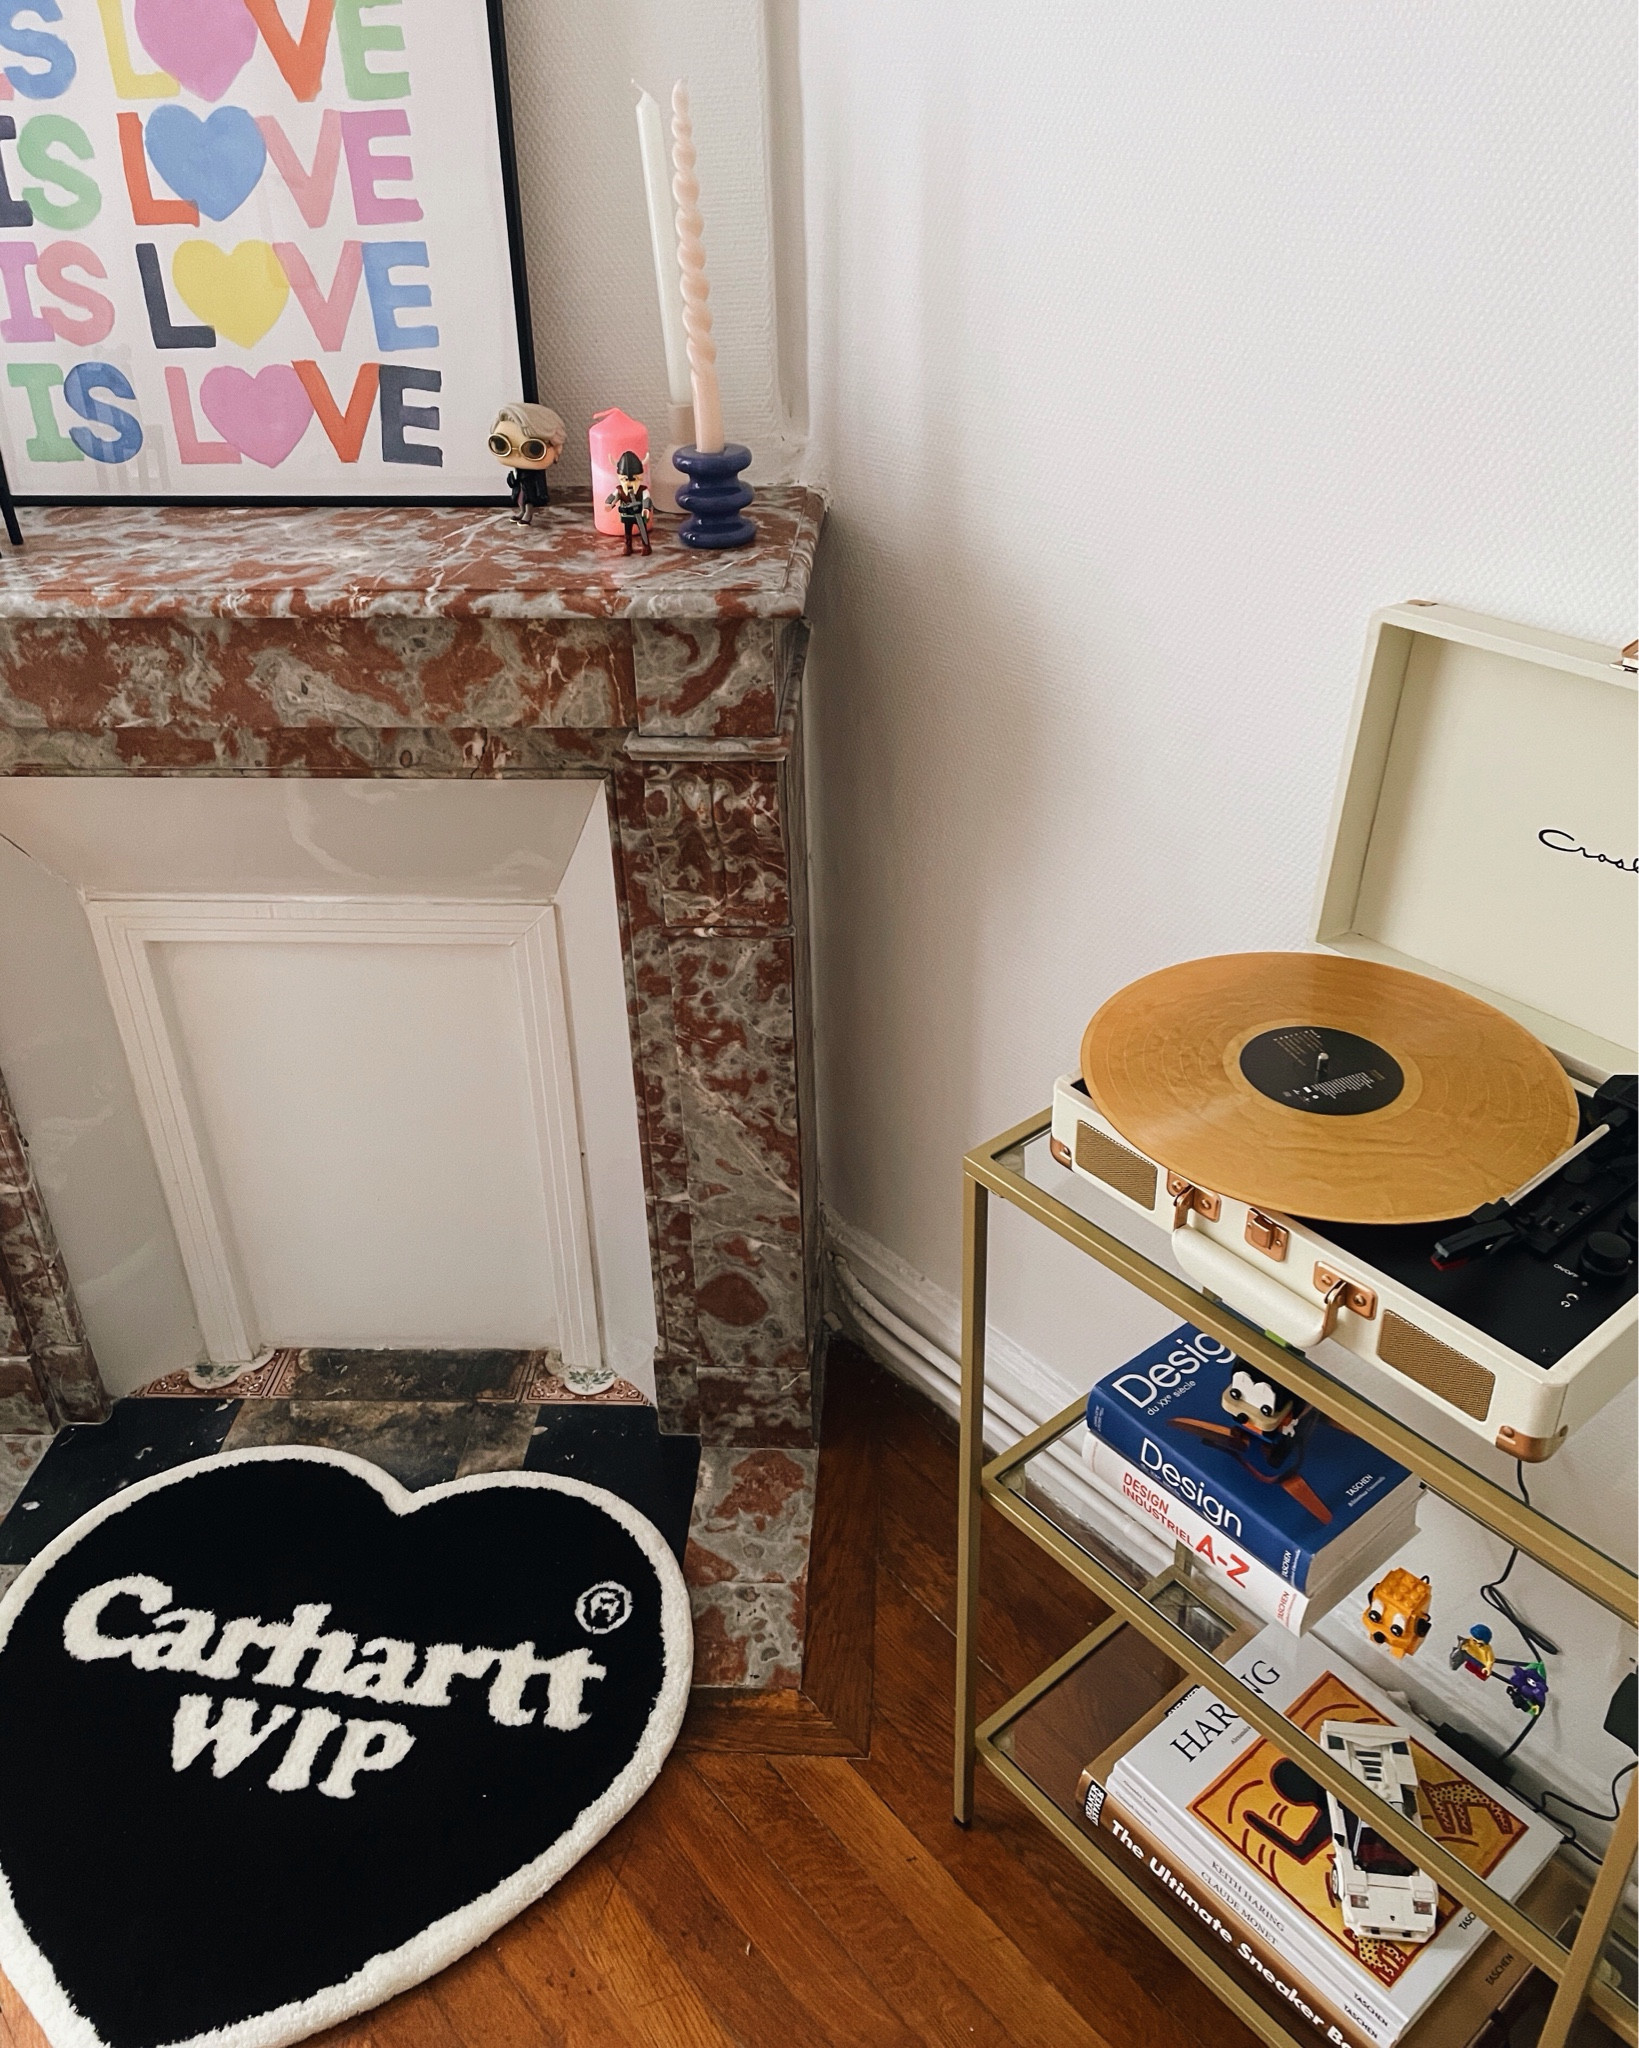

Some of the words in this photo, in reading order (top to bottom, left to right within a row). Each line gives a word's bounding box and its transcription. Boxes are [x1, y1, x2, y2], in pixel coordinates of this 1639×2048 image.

[7, 361, 143, 464] IS
[1147, 1405, 1160, 1417] du
[1173, 1380, 1196, 1398] siècle
[1123, 1472, 1169, 1515] DESIGN
[1123, 1485, 1193, 1548] INDUSTRIEL
[1141, 1437, 1242, 1537] Design
[1345, 1473, 1374, 1497] TASCHEN
[1195, 1534, 1250, 1589] A-Z
[62, 1573, 606, 1731] Carhartt
[170, 1693, 416, 1799] WIP
[1112, 1819, 1145, 1860] The
[1149, 1857, 1233, 1944] Ultimate
[1237, 1942, 1325, 2026] Sneaker
[1201, 1871, 1240, 1910] CLAUDE
[1241, 1909, 1279, 1946] MONET
[1212, 1861, 1242, 1893] KEITH
[1244, 1891, 1285, 1932] HARING
[1485, 1952, 1515, 1986] TASCHEN
[1343, 2004, 1378, 2039] TASCHEN
[1353, 1992, 1389, 2027] TASCHEN
